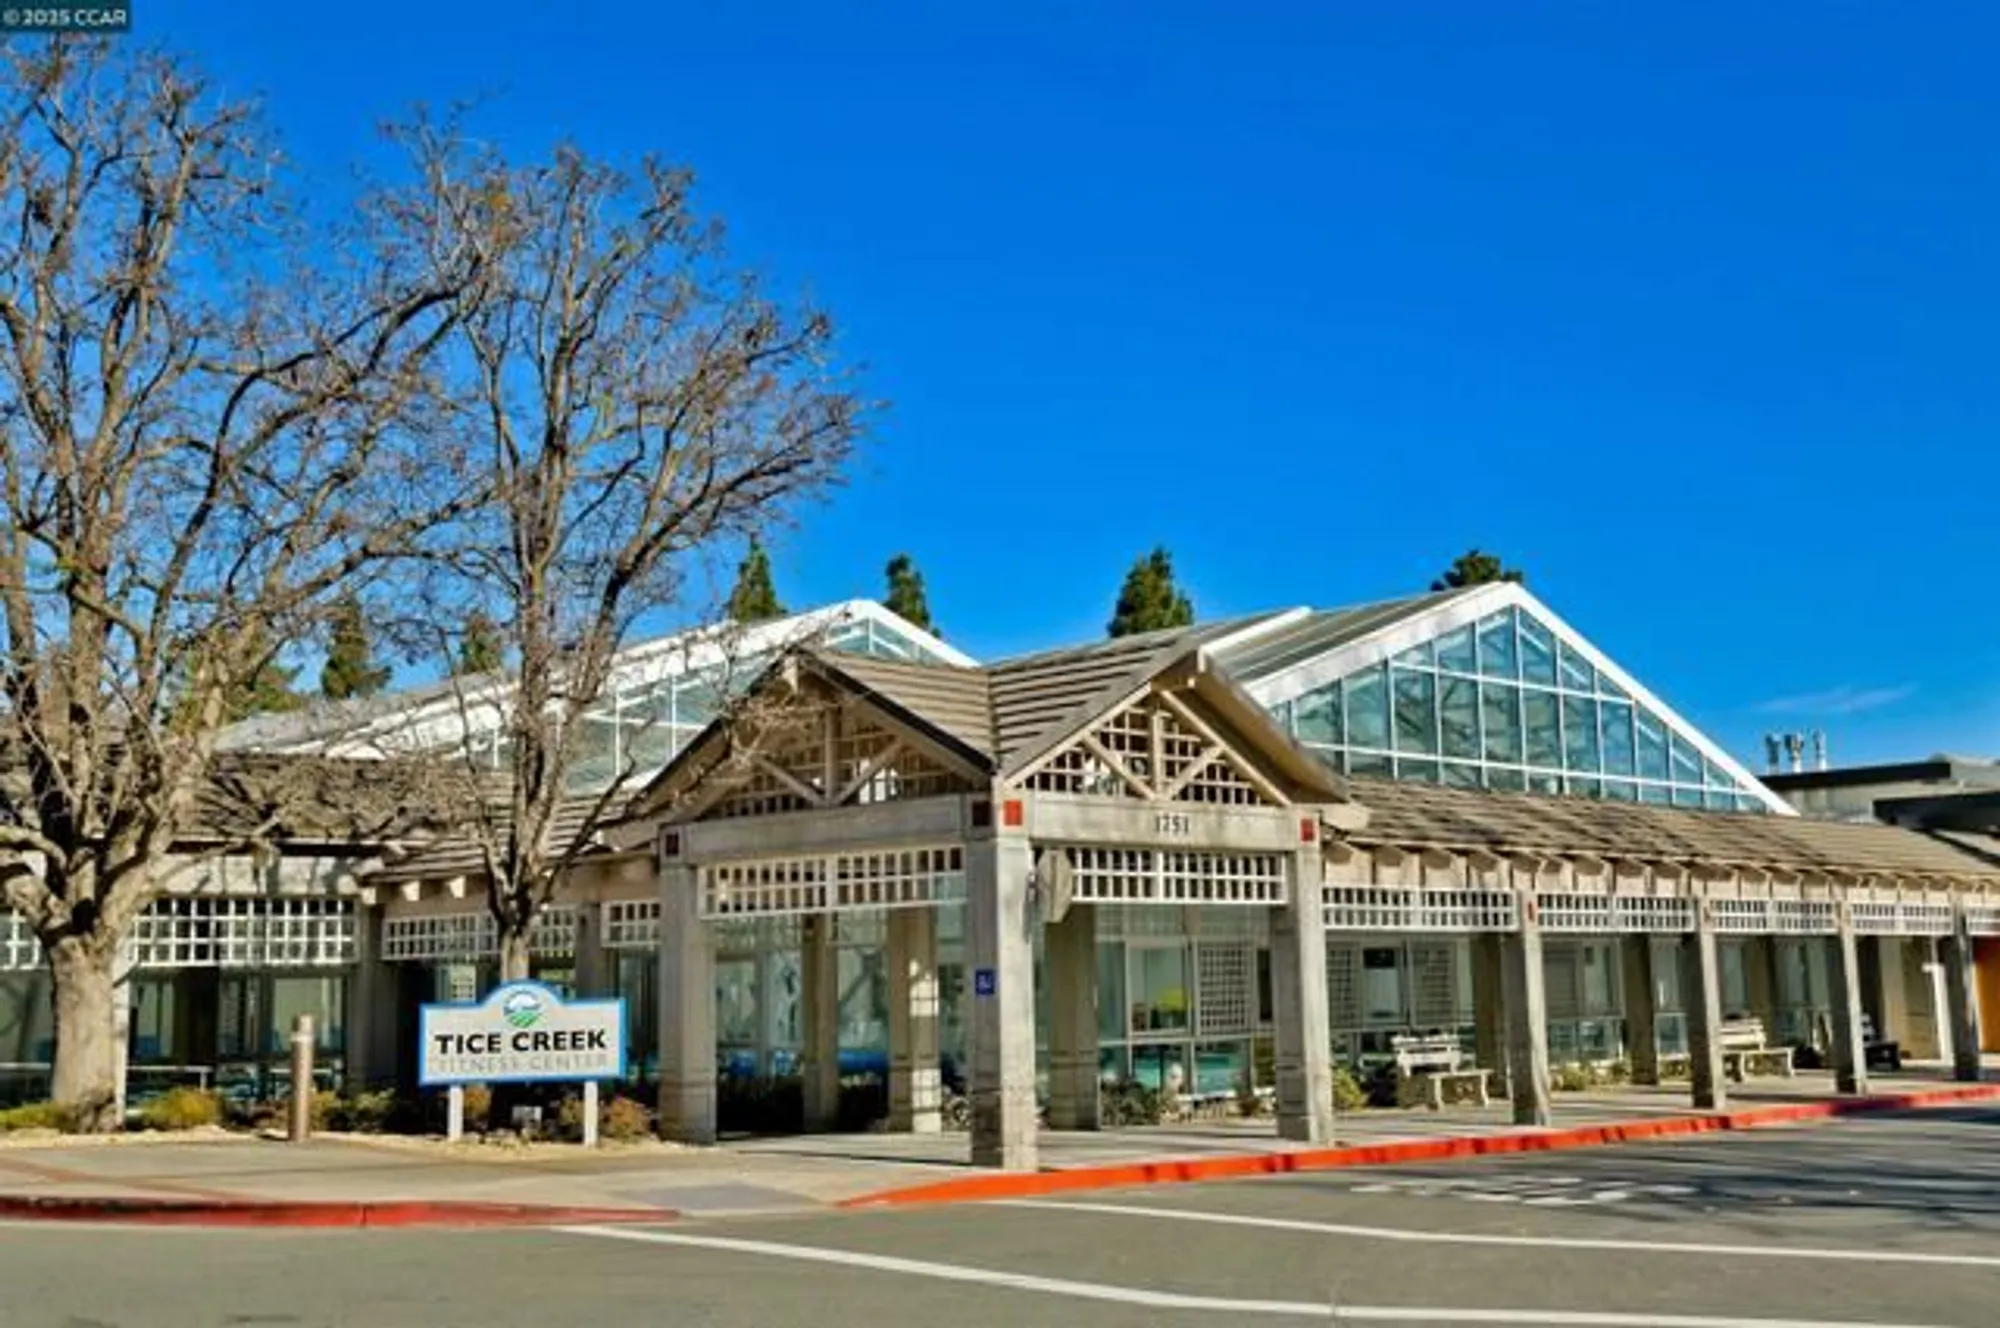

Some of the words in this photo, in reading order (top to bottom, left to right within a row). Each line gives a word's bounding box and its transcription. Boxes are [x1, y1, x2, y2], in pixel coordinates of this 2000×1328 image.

[434, 1033, 502, 1055] TICE
[511, 1029, 607, 1052] CREEK
[528, 1052, 608, 1071] CENTER
